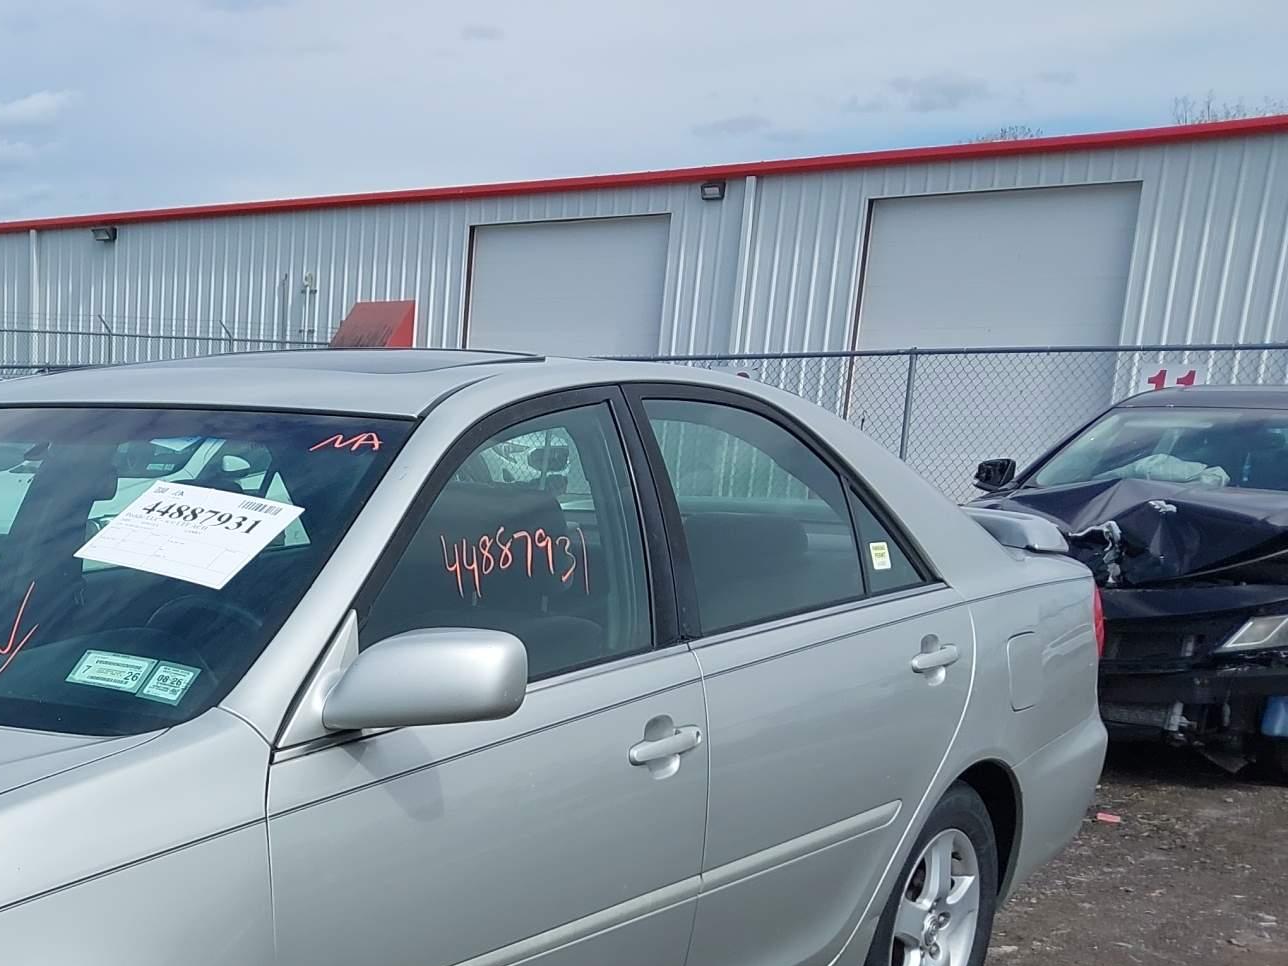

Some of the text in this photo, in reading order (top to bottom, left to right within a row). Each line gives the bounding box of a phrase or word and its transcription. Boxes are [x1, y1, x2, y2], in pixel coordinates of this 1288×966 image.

[142, 500, 263, 534] 44887931
[440, 526, 590, 599] 44887931
[123, 671, 141, 682] 26
